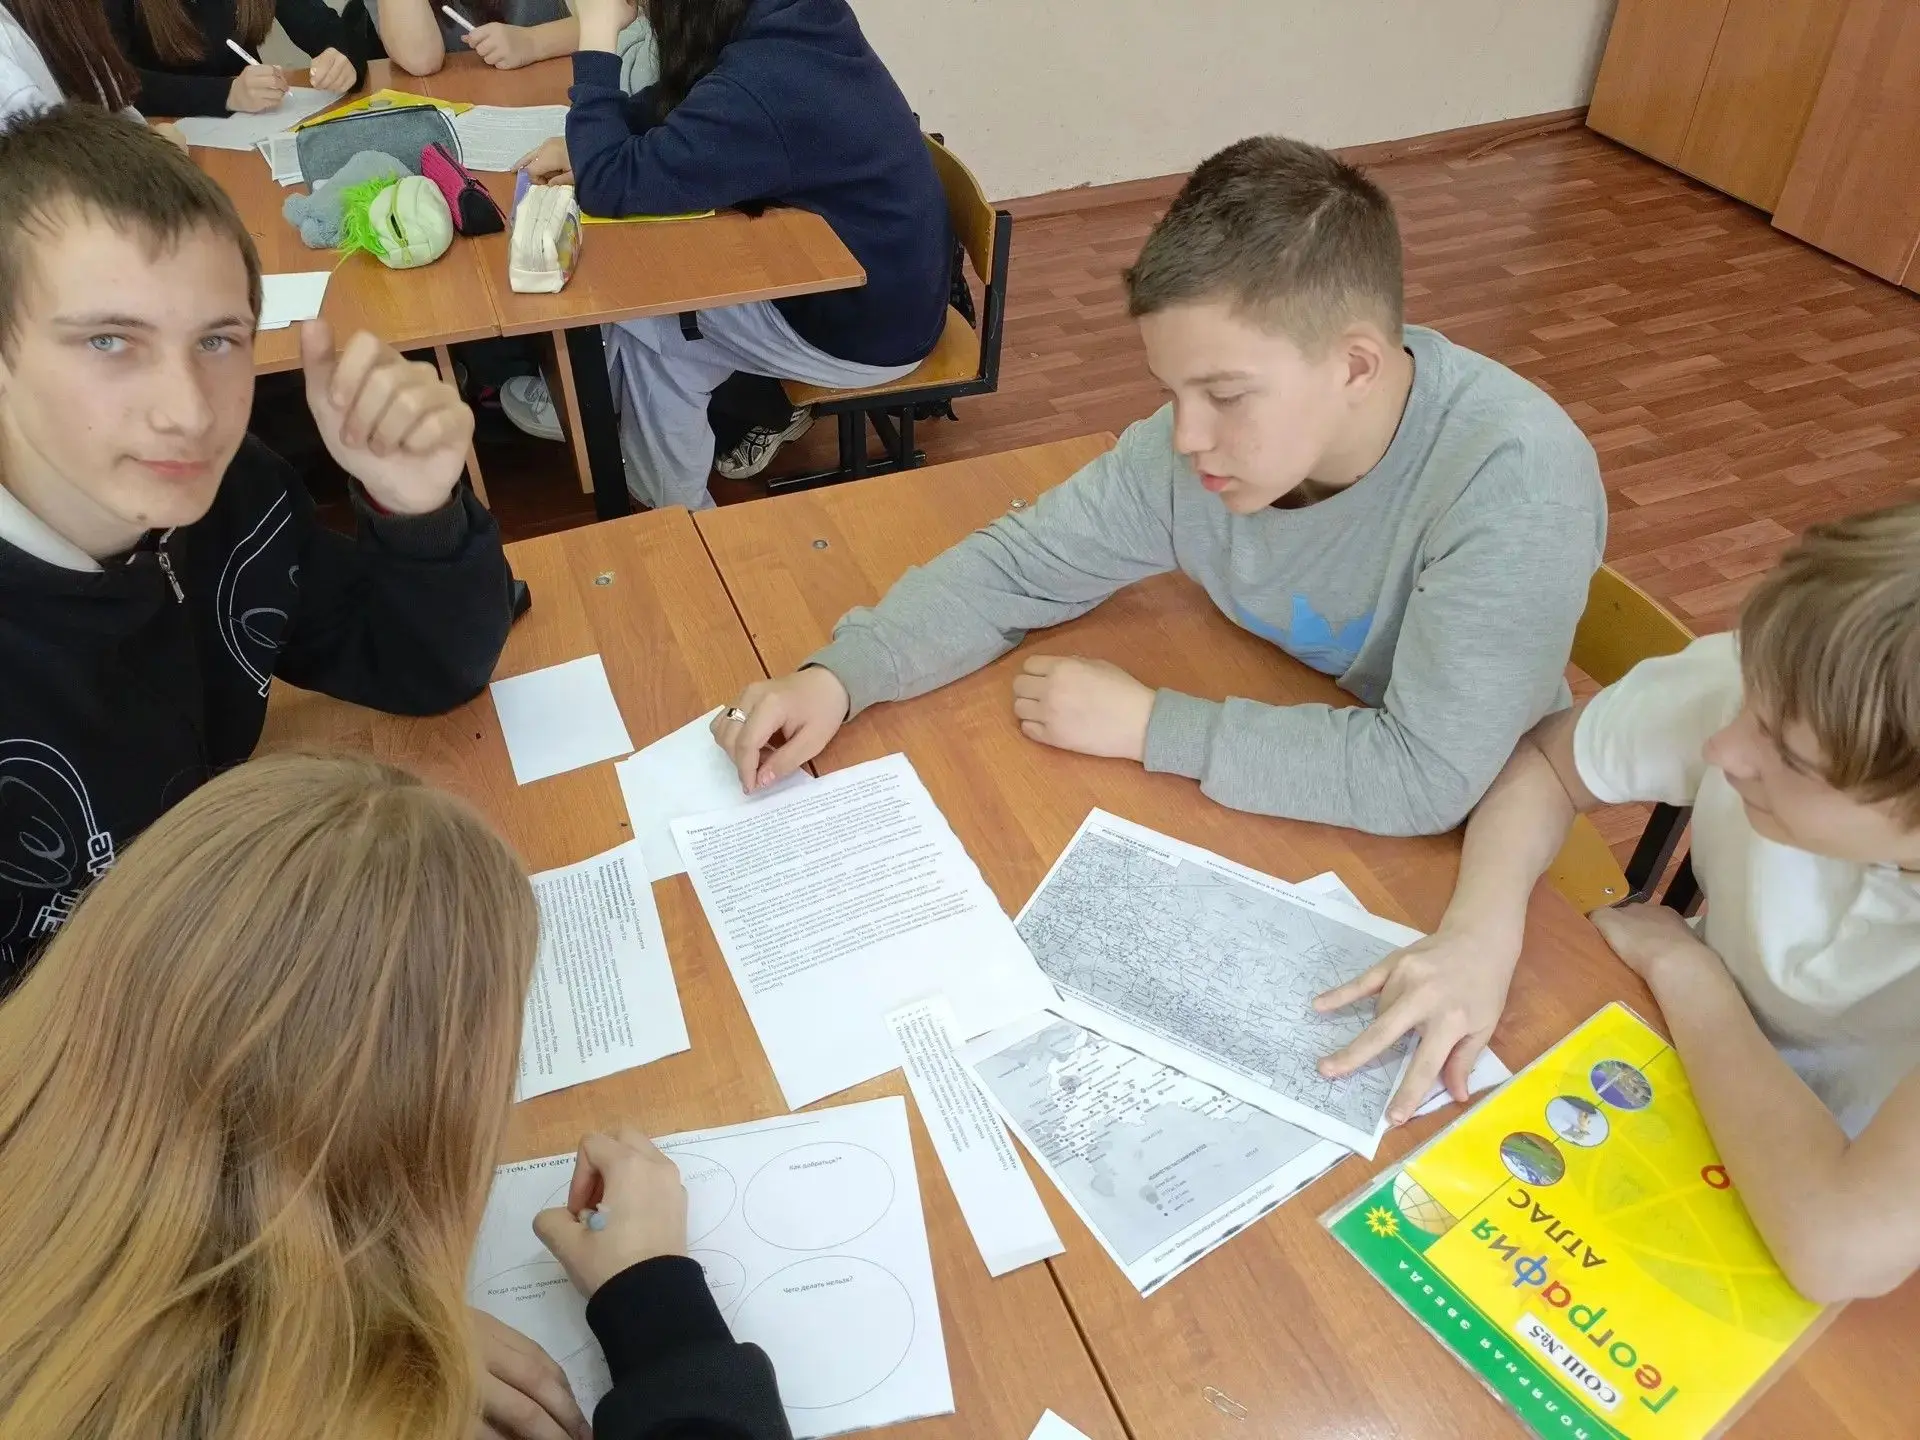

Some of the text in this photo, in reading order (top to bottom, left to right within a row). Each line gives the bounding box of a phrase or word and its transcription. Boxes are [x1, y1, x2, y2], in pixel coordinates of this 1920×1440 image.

[507, 1165, 526, 1174] тем,
[529, 1161, 546, 1170] кто
[549, 1158, 569, 1167] едет
[1507, 1188, 1608, 1268] АТЛАС
[487, 1287, 509, 1296] Когда
[510, 1283, 532, 1293] лучше
[800, 1282, 825, 1292] делать
[1471, 1217, 1679, 1414] География
[1398, 1259, 1589, 1440] ПОЛЯРНАЯ ЗВЕЗДА
[1529, 1324, 1617, 1404] СОШ №5
